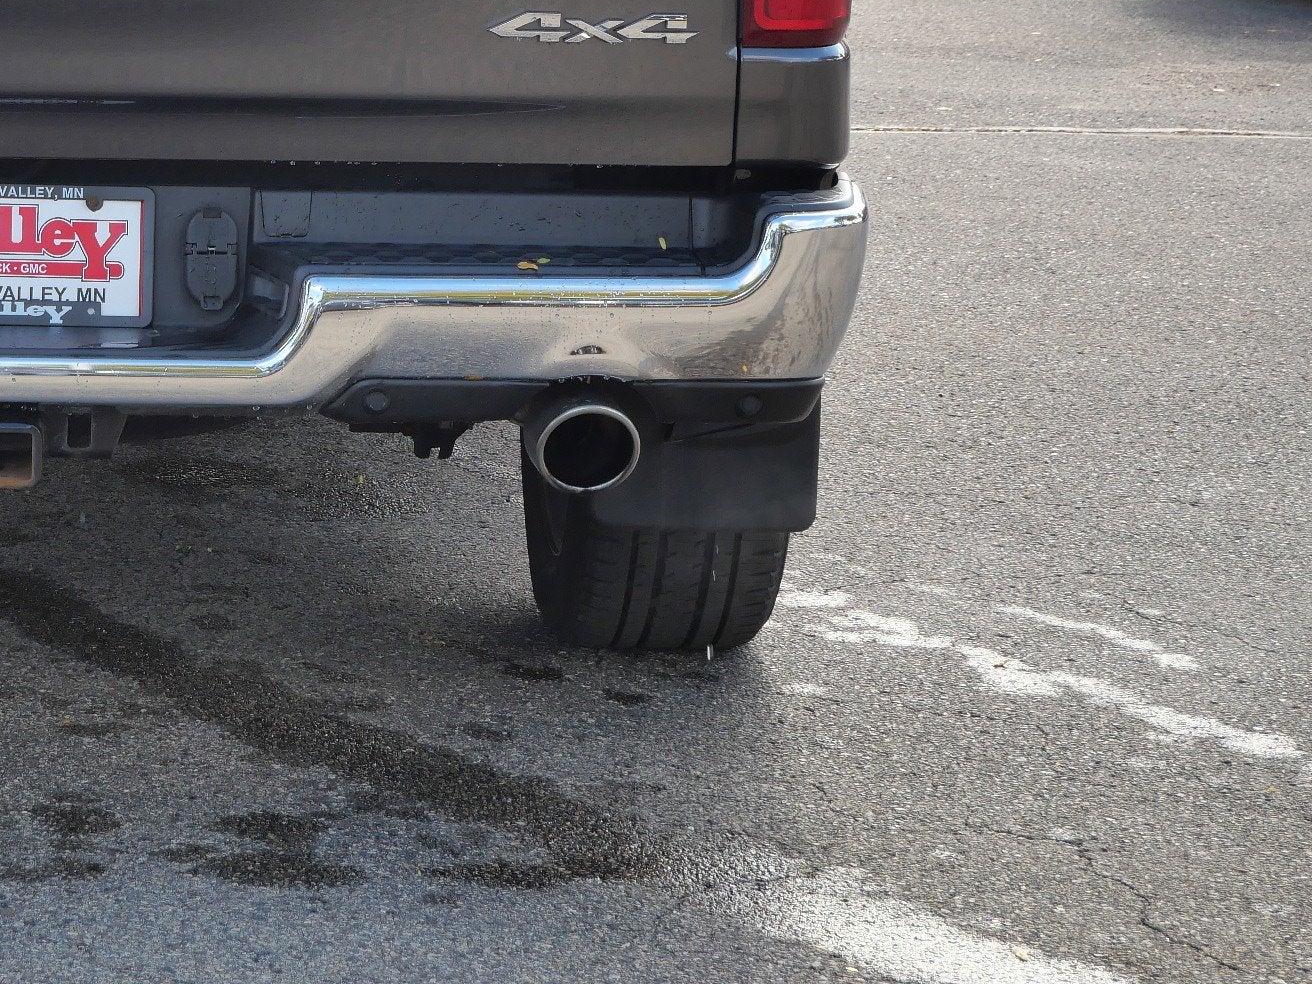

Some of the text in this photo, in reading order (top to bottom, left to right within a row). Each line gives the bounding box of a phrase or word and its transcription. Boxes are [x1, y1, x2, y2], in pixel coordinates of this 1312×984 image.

[62, 186, 85, 200] MN
[20, 263, 48, 275] GMC
[76, 287, 107, 304] MN
